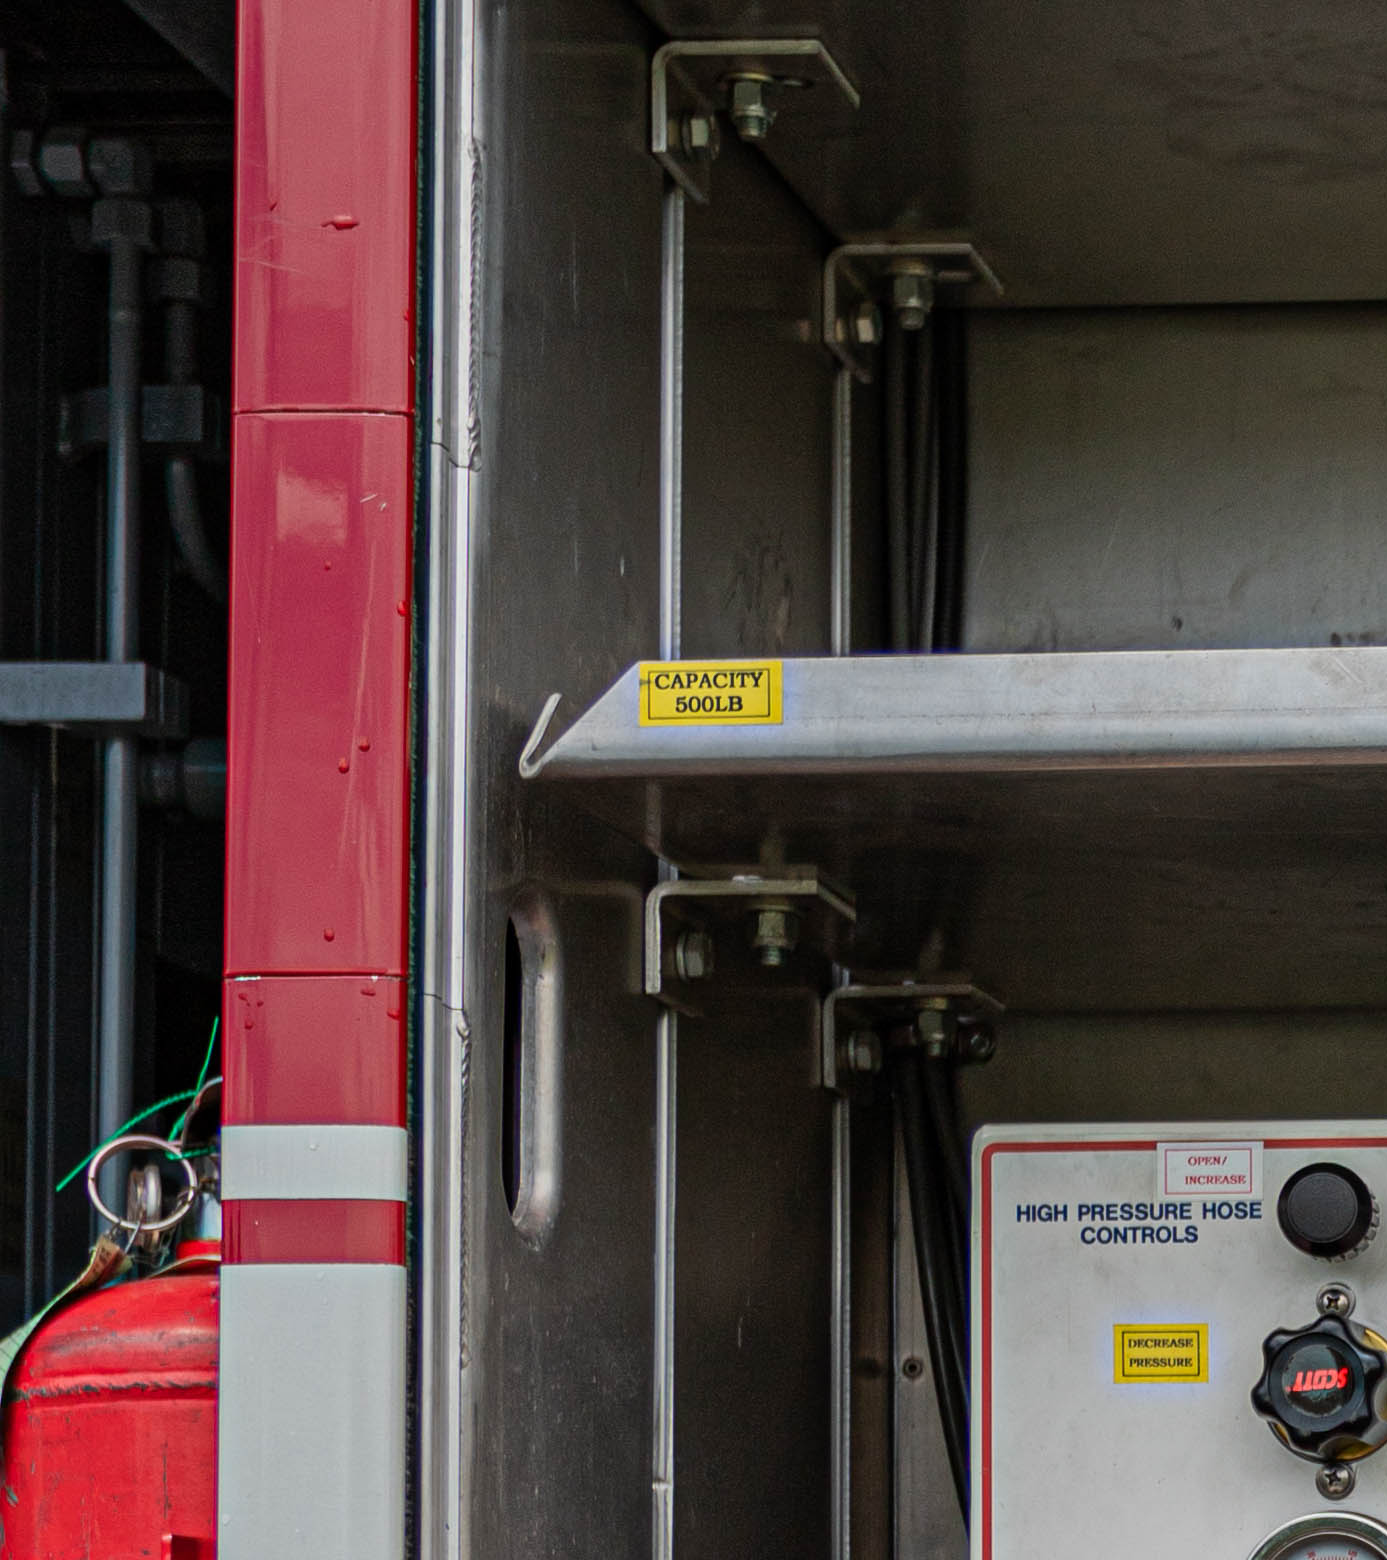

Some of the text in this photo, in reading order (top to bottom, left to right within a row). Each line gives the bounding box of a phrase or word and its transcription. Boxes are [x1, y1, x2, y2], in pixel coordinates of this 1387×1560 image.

[655, 672, 763, 689] CAPACITY
[676, 696, 743, 713] 500LB
[1188, 1156, 1227, 1166] OPEN/
[1185, 1174, 1246, 1185] INCREASE
[1017, 1202, 1262, 1222] HIGH PRESSURE HOSE
[1081, 1225, 1198, 1244] CONTROLS
[1128, 1338, 1193, 1348] DECREASE
[1130, 1358, 1192, 1367] PRESSURE
[1293, 1367, 1349, 1392] SCOTT
